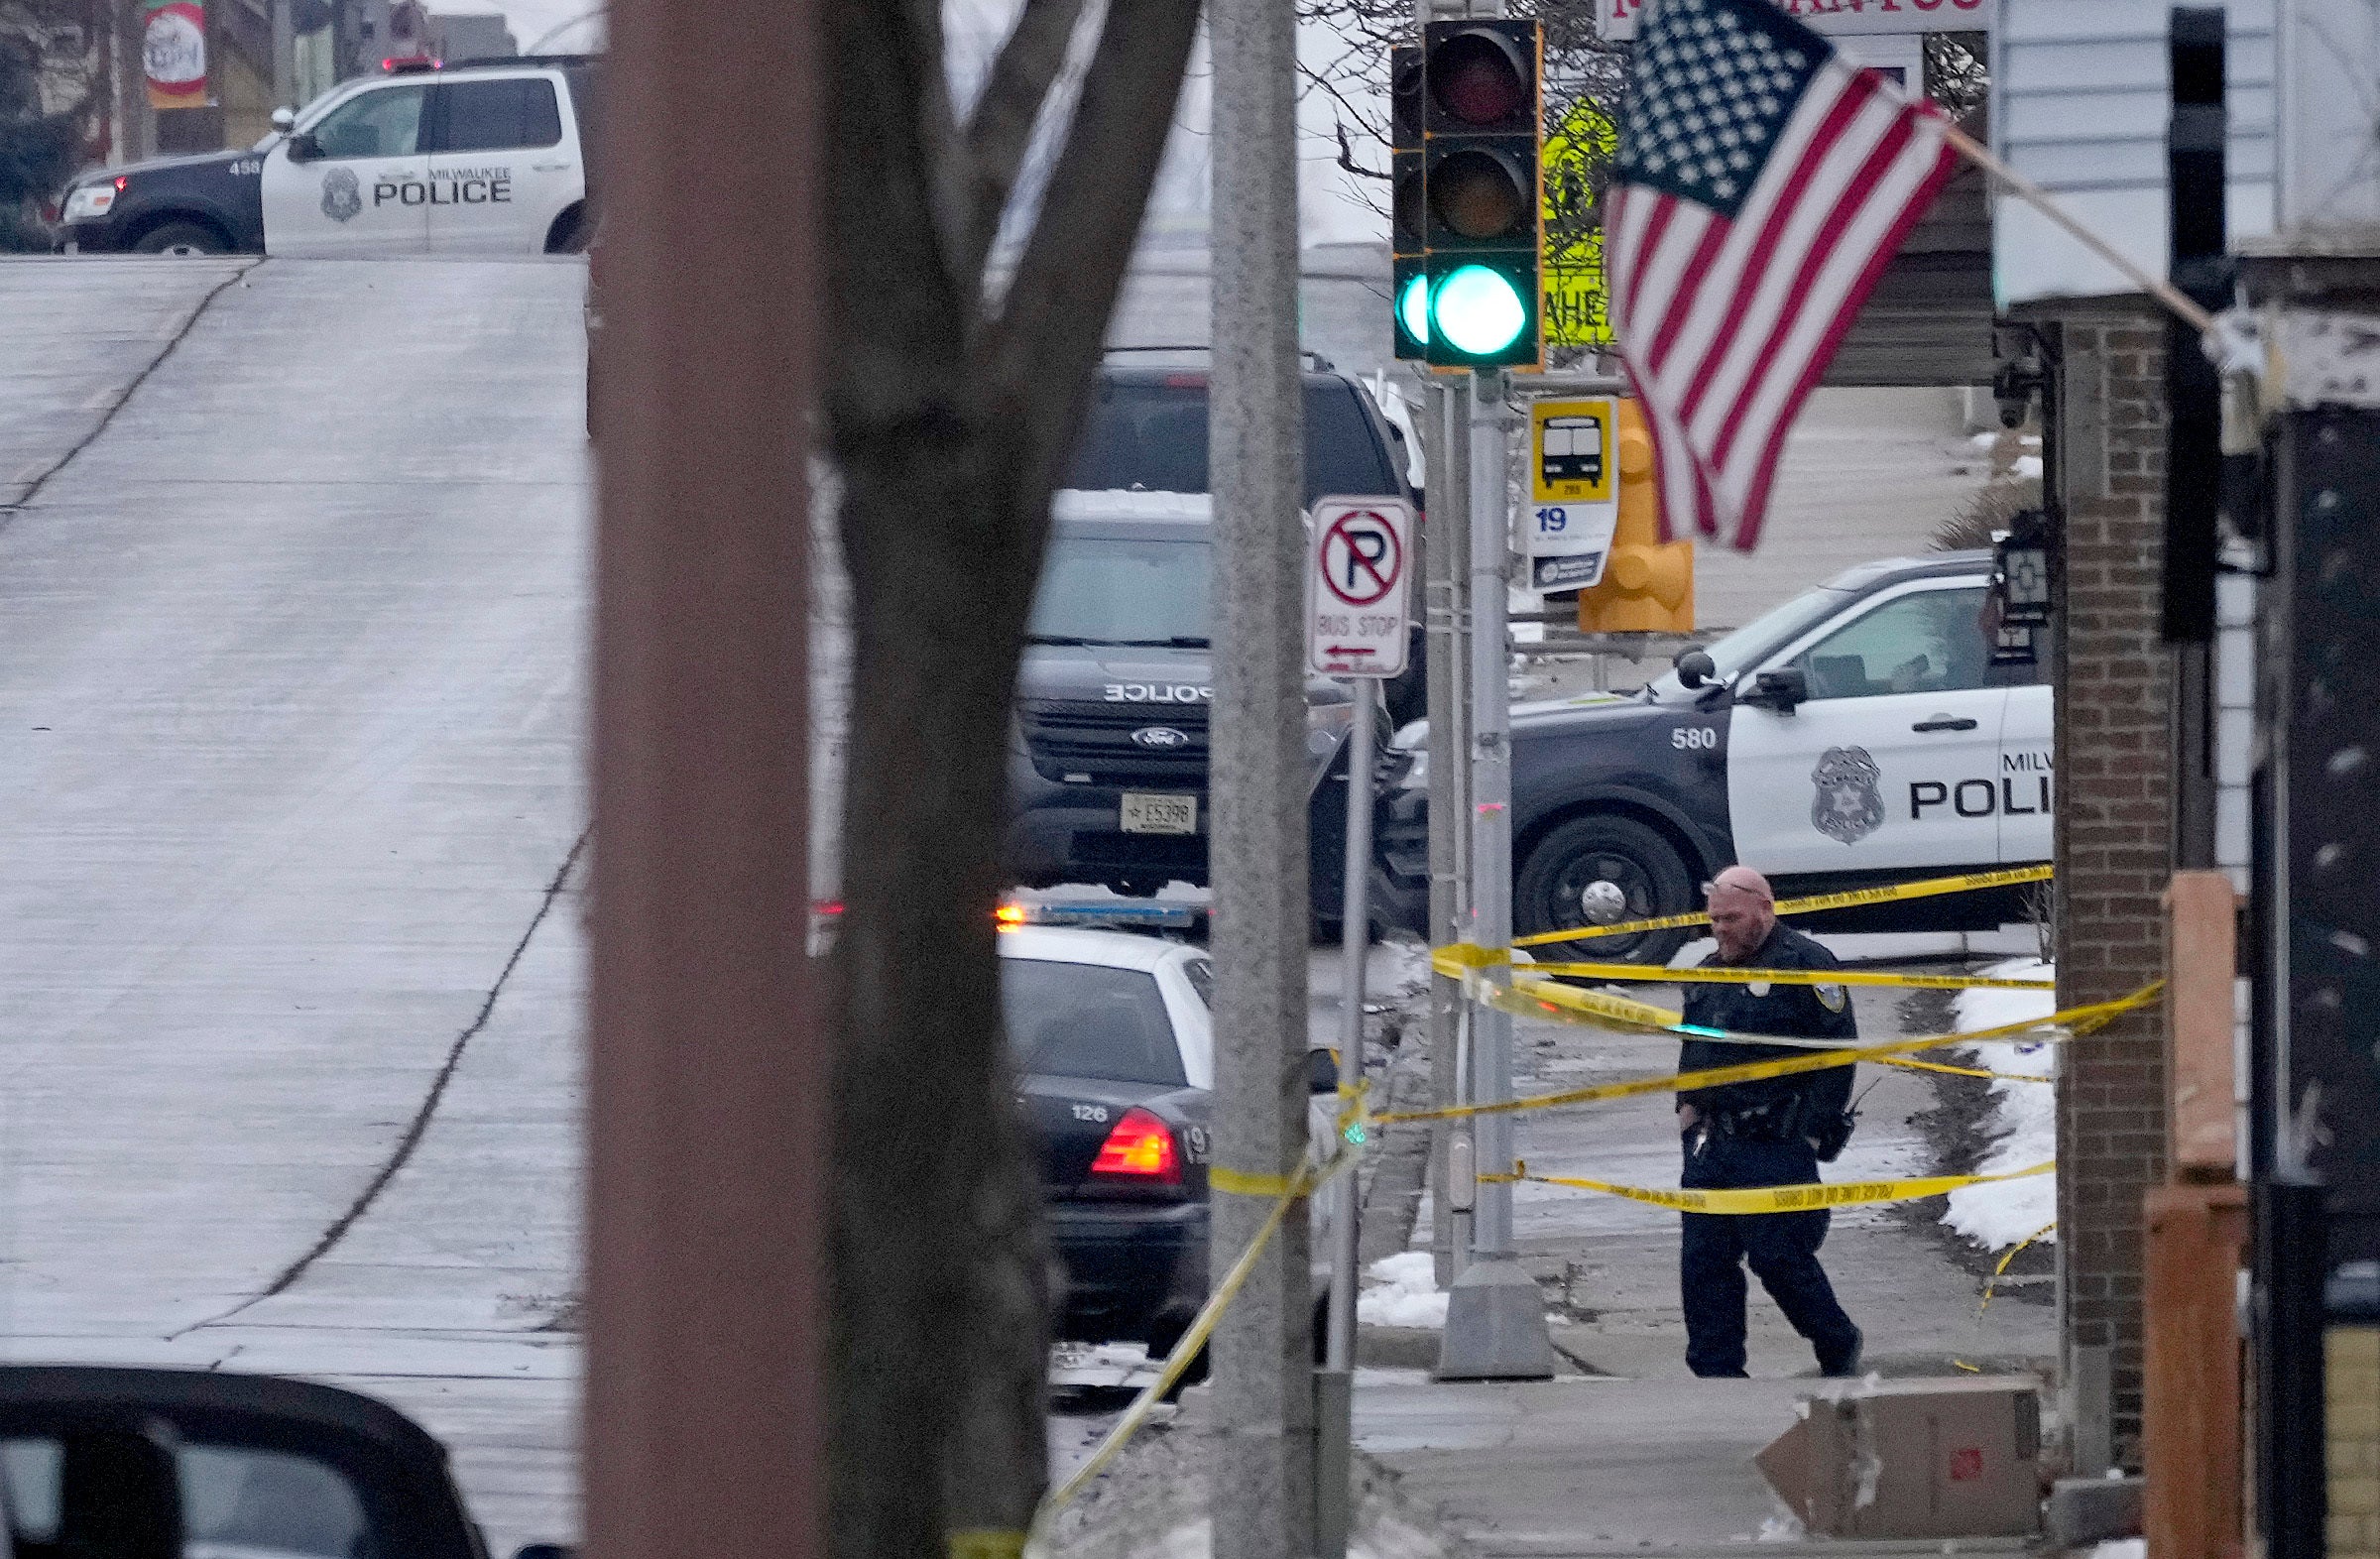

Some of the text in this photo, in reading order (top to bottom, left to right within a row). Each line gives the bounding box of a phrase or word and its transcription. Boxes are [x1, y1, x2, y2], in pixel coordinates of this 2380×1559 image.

[427, 167, 511, 180] MILWAUKEE
[374, 180, 511, 206] POLICE
[1543, 290, 1609, 327] AHE
[1535, 507, 1567, 533] 19
[1318, 614, 1399, 636] BUS STOP
[1671, 727, 1717, 750] 580
[1908, 776, 2050, 819] POLI
[1072, 1104, 1108, 1123] 126
